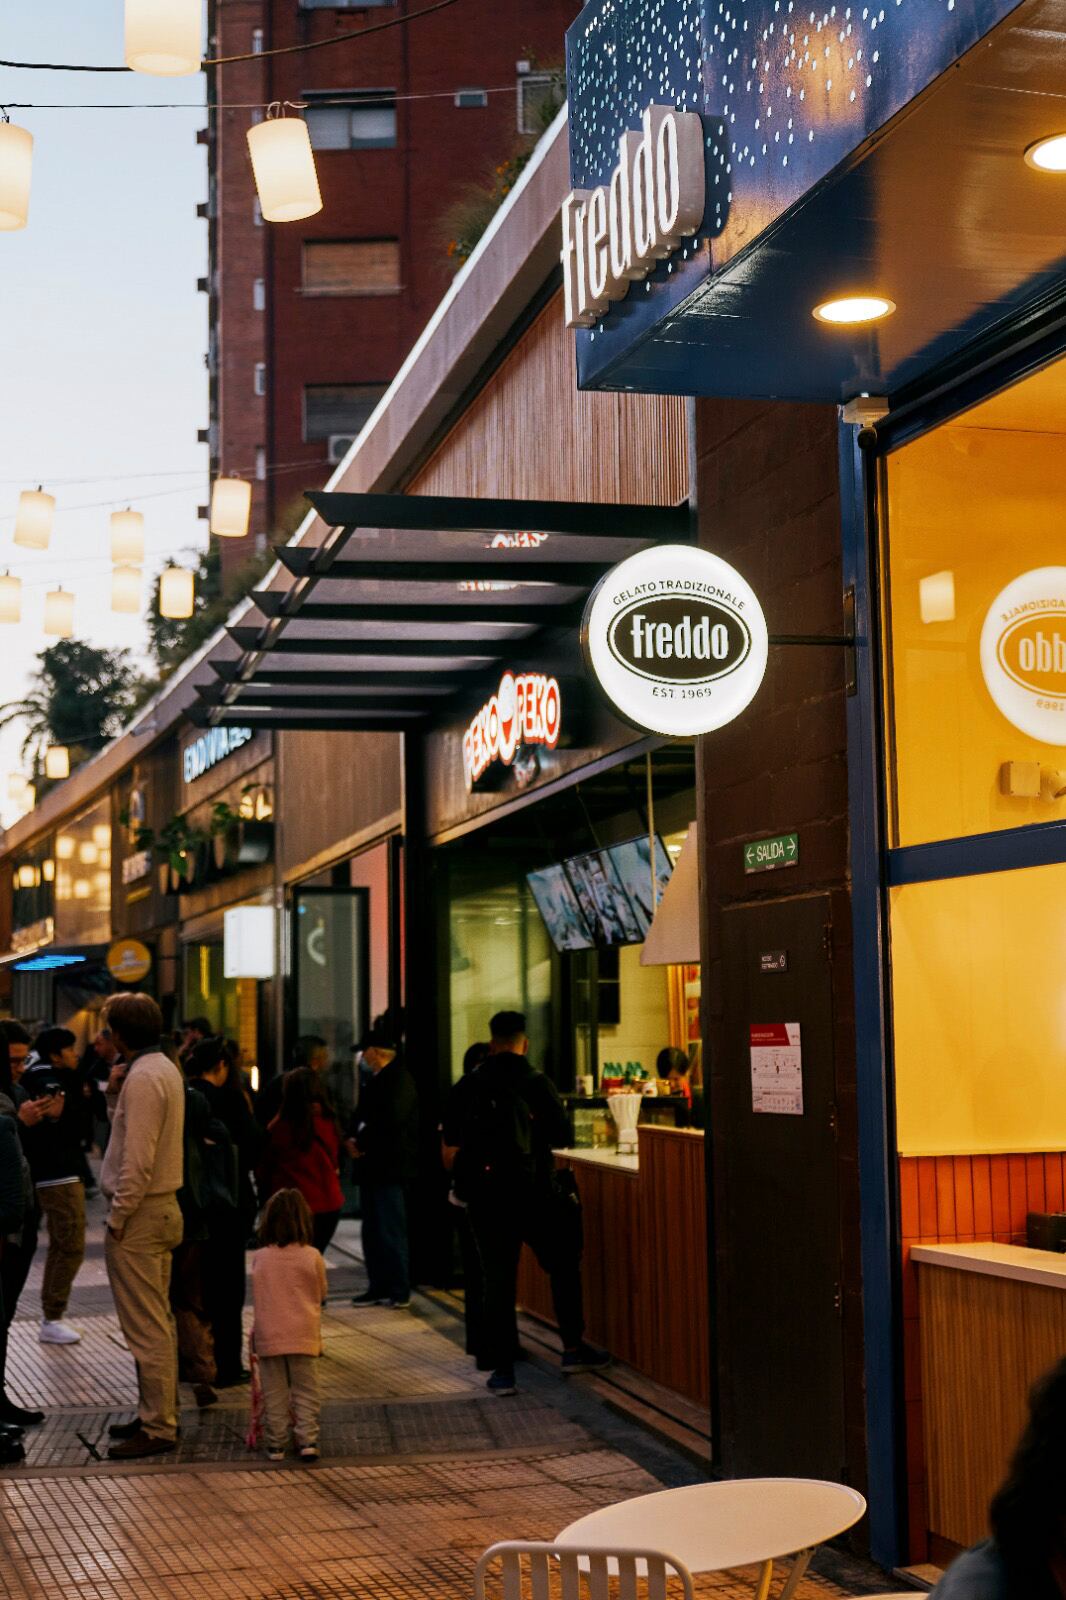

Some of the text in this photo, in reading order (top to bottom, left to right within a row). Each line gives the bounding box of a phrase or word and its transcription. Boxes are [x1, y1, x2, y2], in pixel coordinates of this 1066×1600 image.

[560, 105, 684, 328] freddo
[612, 580, 746, 611] GELATO TRADIZIONALE
[630, 614, 729, 660] freddo
[515, 672, 561, 750] PEKO
[682, 687, 712, 699] 1969
[756, 841, 785, 862] SALIDA
